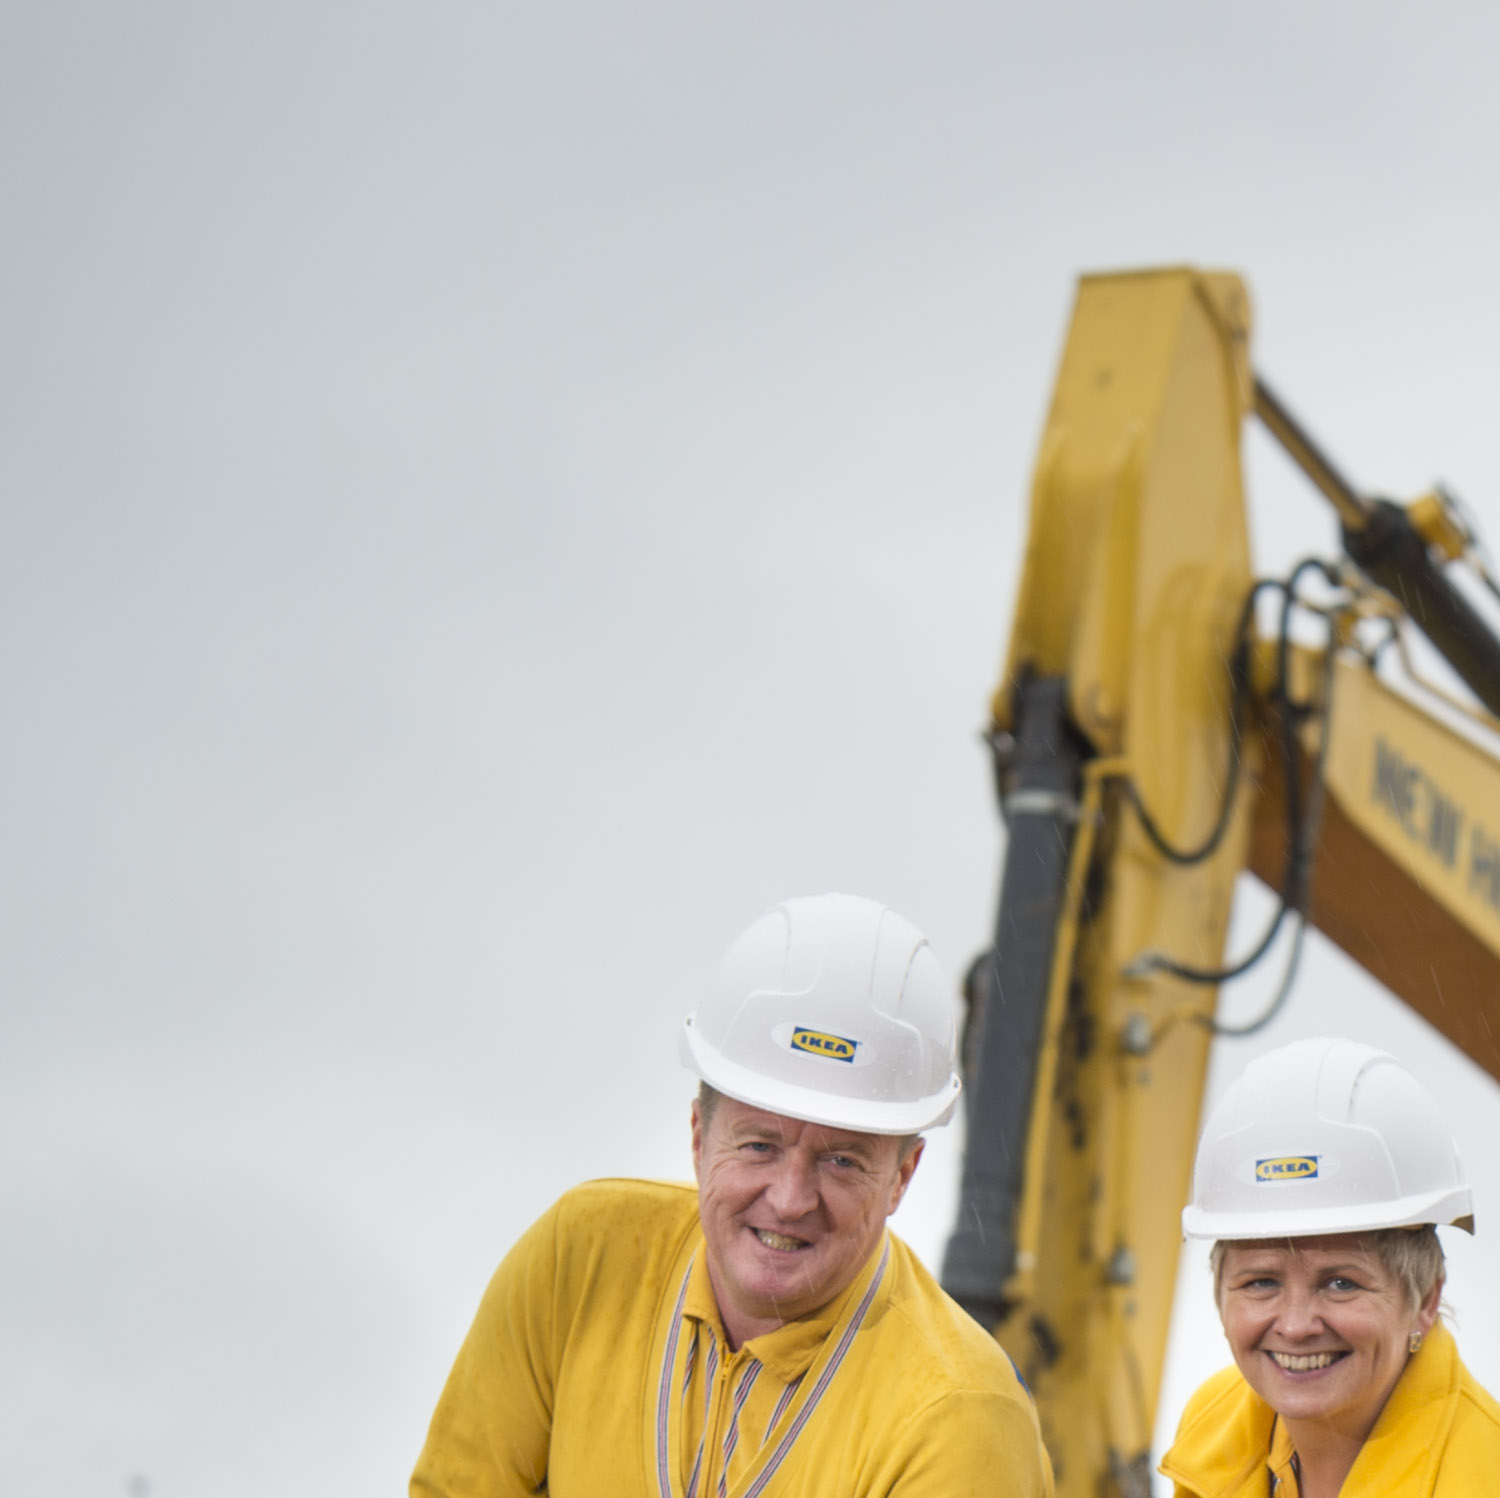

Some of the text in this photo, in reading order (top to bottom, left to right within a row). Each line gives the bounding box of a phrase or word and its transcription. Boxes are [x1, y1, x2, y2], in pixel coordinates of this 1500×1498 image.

[1371, 732, 1464, 873] NEW
[801, 1034, 848, 1055] IKEA
[1263, 1162, 1311, 1175] IKEA
